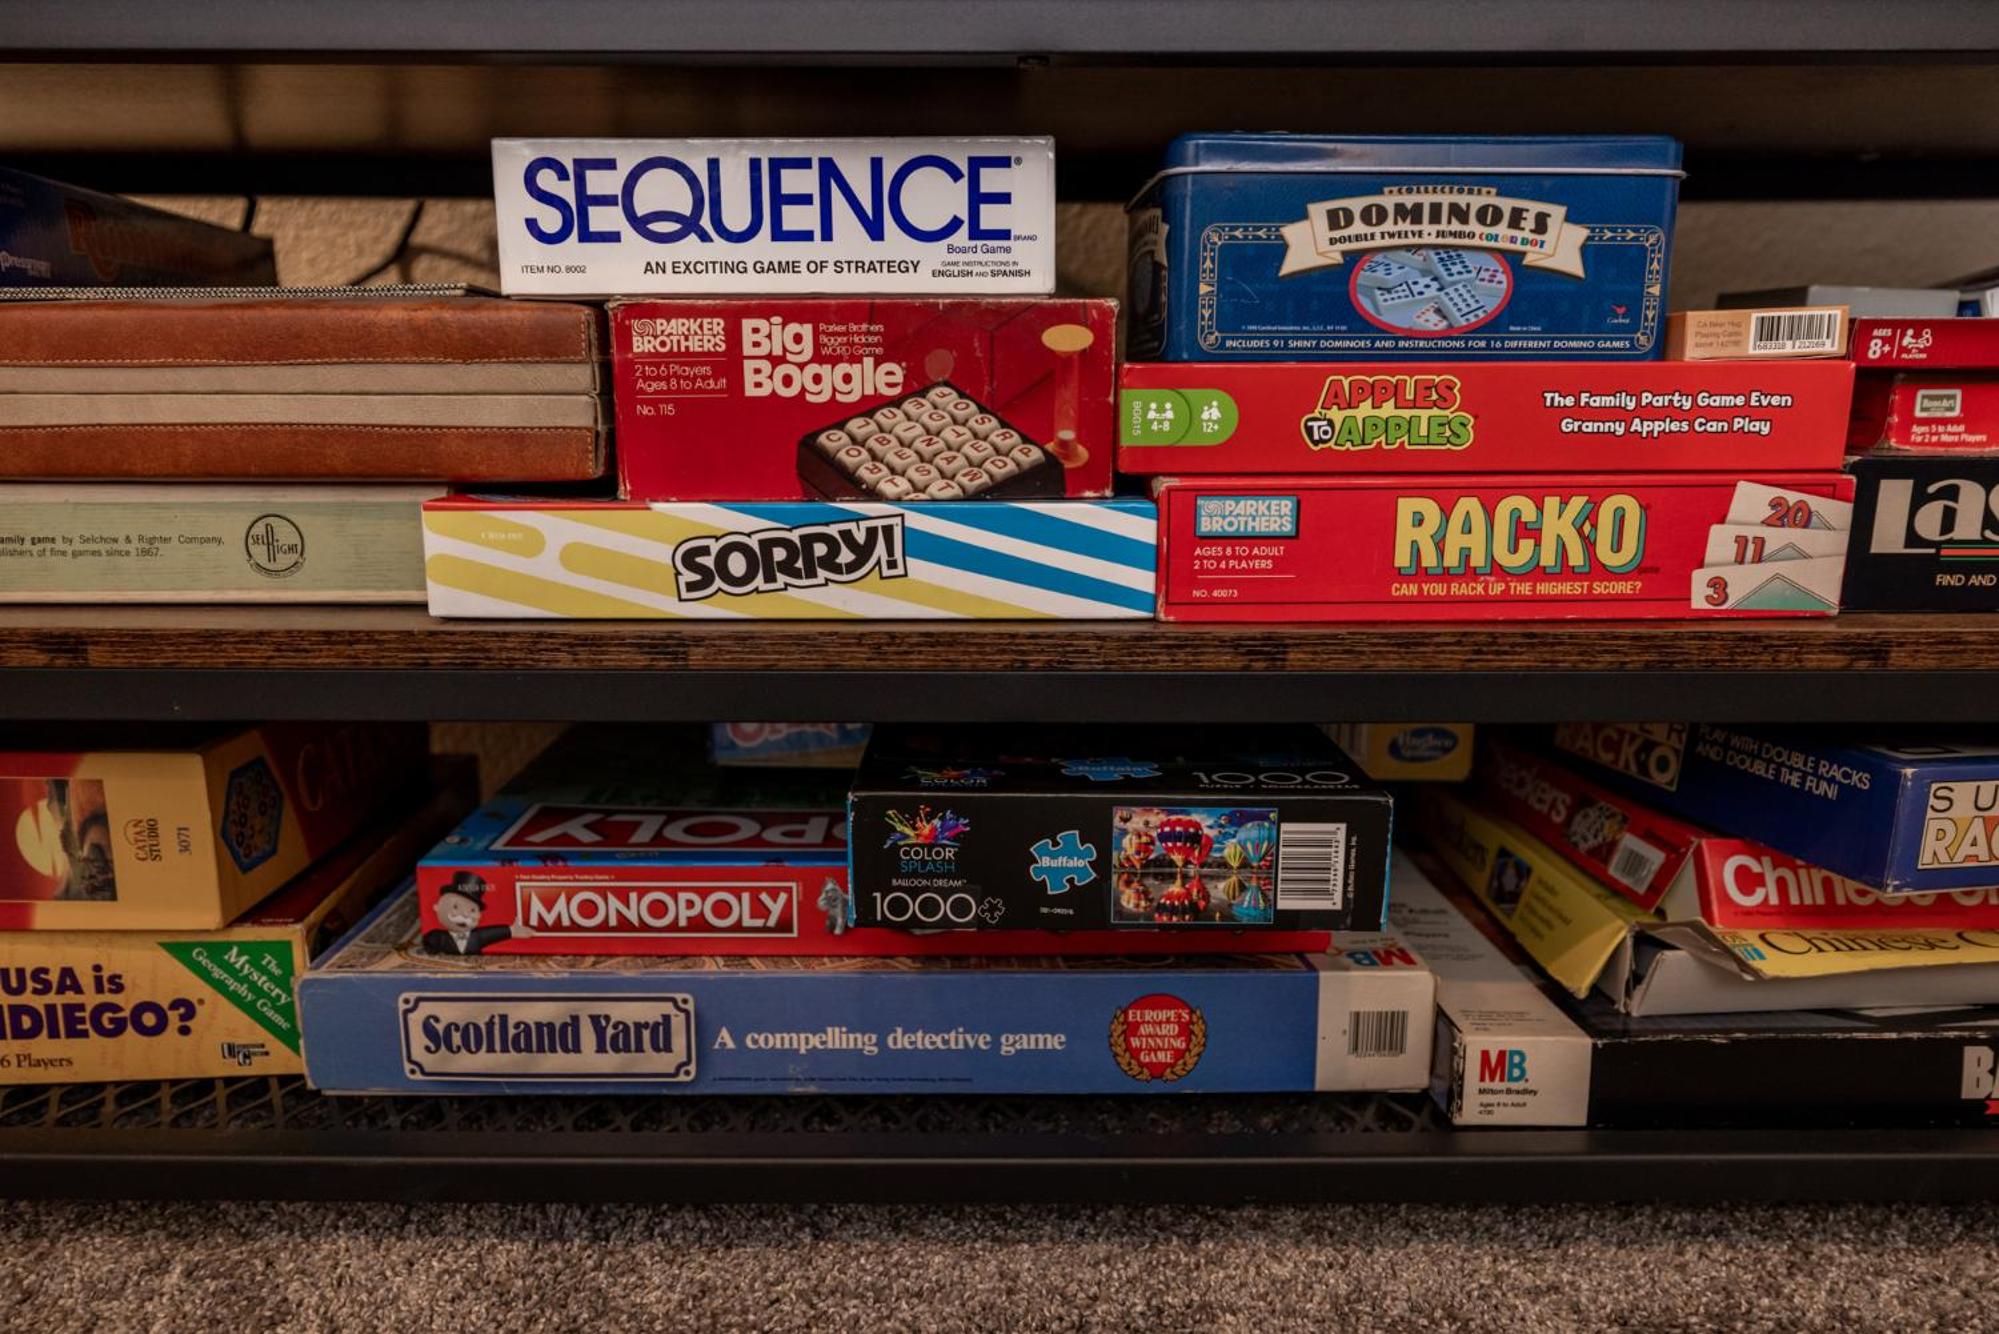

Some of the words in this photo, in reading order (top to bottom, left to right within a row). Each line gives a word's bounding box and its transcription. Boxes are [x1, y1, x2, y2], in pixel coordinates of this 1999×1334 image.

[523, 155, 1012, 245] SEQUENCE
[1325, 201, 1552, 235] DOMINOES
[1328, 231, 1377, 246] DOUBLE
[1380, 229, 1424, 241] TWELVE
[1434, 230, 1476, 241] JUMBO
[1478, 231, 1518, 246] COLOR
[1519, 236, 1546, 250] DOT
[946, 243, 978, 254] Board
[981, 243, 1012, 254] Game
[521, 265, 545, 274] ITEM
[546, 265, 564, 274] NO.
[565, 264, 587, 274] 8002
[643, 260, 667, 275] AN
[672, 260, 748, 275] EXCITING
[753, 260, 802, 275] GAME
[806, 260, 829, 274] OF
[833, 260, 921, 274] STRATEGY
[931, 269, 974, 278] ENGLISH
[989, 268, 1031, 278] SPANISH
[655, 318, 725, 336] PARKER
[819, 322, 847, 333] Parker
[848, 322, 884, 333] Brothers
[1872, 328, 1892, 337] AGES
[632, 335, 726, 353] BROTHERS
[741, 316, 814, 363] Big
[819, 333, 847, 346] Bigger
[848, 333, 883, 344] Hidden
[1225, 339, 1271, 349] INCLUDES
[1272, 339, 1285, 349] 91
[1288, 339, 1317, 349] SHINY
[1320, 339, 1372, 349] DOMINOES
[1374, 340, 1397, 349] AND
[1398, 340, 1466, 349] INSTRUCTIONS
[1468, 340, 1487, 349] FOR
[1490, 340, 1502, 349] 16
[1504, 340, 1551, 349] DIFFERENT
[1553, 340, 1595, 349] DOMINO
[1597, 340, 1630, 349] GAMES
[820, 346, 851, 355] WORD
[852, 345, 884, 355] Game
[1867, 338, 1891, 360] 8+
[634, 365, 643, 377] 2
[644, 365, 657, 377] to
[659, 365, 667, 377] 6
[669, 364, 713, 378] Players
[635, 378, 668, 392] Ages
[669, 377, 678, 390] 8
[679, 378, 692, 390] to
[693, 378, 727, 390] Adult
[743, 356, 904, 404] Boggle
[1321, 378, 1459, 410] APPLES
[1543, 391, 1575, 408] The
[1580, 391, 1636, 410] Family
[1641, 391, 1692, 410] Party
[1697, 391, 1745, 407] Game
[1750, 391, 1793, 407] Even
[636, 404, 657, 416] No.
[659, 404, 675, 416] 115
[1150, 420, 1171, 432] 4-8
[1201, 421, 1219, 433] 12+
[1333, 413, 1473, 447] APPLES
[1560, 417, 1626, 435] Granny
[1629, 416, 1689, 437] Apples
[1693, 417, 1728, 433] Can
[1732, 416, 1771, 435] Play
[1224, 500, 1292, 516] PARKER
[1761, 495, 1812, 528] 20
[1200, 516, 1292, 533] BROTHERS
[31, 536, 57, 546] game
[61, 534, 73, 546] by
[79, 534, 119, 545] Selchow
[124, 534, 133, 545] &
[138, 534, 172, 546] Righter
[178, 534, 225, 546] Company,
[71, 549, 103, 560] games
[678, 522, 901, 594] SORRY!
[1194, 546, 1223, 557] AGES
[1225, 546, 1232, 556] 8
[1234, 546, 1249, 556] TO
[1251, 545, 1285, 556] ADULT
[1733, 534, 1766, 566] 11
[1193, 560, 1200, 570] 2
[1202, 560, 1217, 570] TO
[1219, 559, 1227, 570] 4
[1228, 559, 1274, 570] PLAYERS
[1391, 582, 1418, 596] CAN
[1421, 582, 1447, 596] YOU
[1450, 582, 1484, 596] RACK
[1488, 582, 1506, 595] UP
[1509, 581, 1533, 595] THE
[1536, 581, 1589, 595] HIGHEST
[1592, 580, 1642, 595] SCORE?
[1935, 574, 1965, 586] FIND
[1967, 574, 1997, 586] AND
[1192, 589, 1210, 599] NO.
[1211, 589, 1238, 599] 40073
[1704, 575, 1729, 607] 3
[1729, 731, 1761, 756] WITH
[1761, 741, 1815, 773] DOUBLE
[1818, 760, 1872, 791] RACKS
[1191, 770, 1351, 785] 1000
[1696, 744, 1724, 763] AND
[1726, 752, 1776, 780] DOUBLE
[1779, 764, 1803, 789] THE
[1804, 777, 1839, 801] FUN!
[132, 818, 149, 862] CATAN
[146, 818, 162, 862] STUDIO
[176, 826, 192, 856] 3071
[900, 847, 955, 861] COLOR
[1041, 856, 1085, 869] Buffalo
[900, 860, 955, 873] SPLASH
[891, 878, 931, 887] BALLOON
[528, 890, 789, 928] MONOPOLY
[871, 891, 977, 923] 1000
[1758, 929, 1960, 955] Chinese
[260, 953, 284, 978] The
[0, 966, 84, 997] USA
[91, 964, 125, 995] is
[223, 945, 292, 1006] Mystery
[191, 946, 255, 1004] Geography
[255, 997, 292, 1033] Game
[0, 997, 197, 1041] DIEGO?
[1126, 1008, 1190, 1023] EUROPE'S
[421, 1013, 582, 1056] Scotland
[588, 1013, 674, 1056] Yard
[1137, 1023, 1179, 1037] AWARD
[713, 1026, 737, 1050] A
[745, 1026, 879, 1056] compelling
[887, 1026, 992, 1051] detective
[999, 1032, 1067, 1057] game
[1129, 1036, 1187, 1050] WINNING
[15, 1053, 74, 1070] Players
[1139, 1049, 1175, 1064] GAME
[1478, 1087, 1503, 1096] Milton
[1505, 1087, 1538, 1097] Bradley
